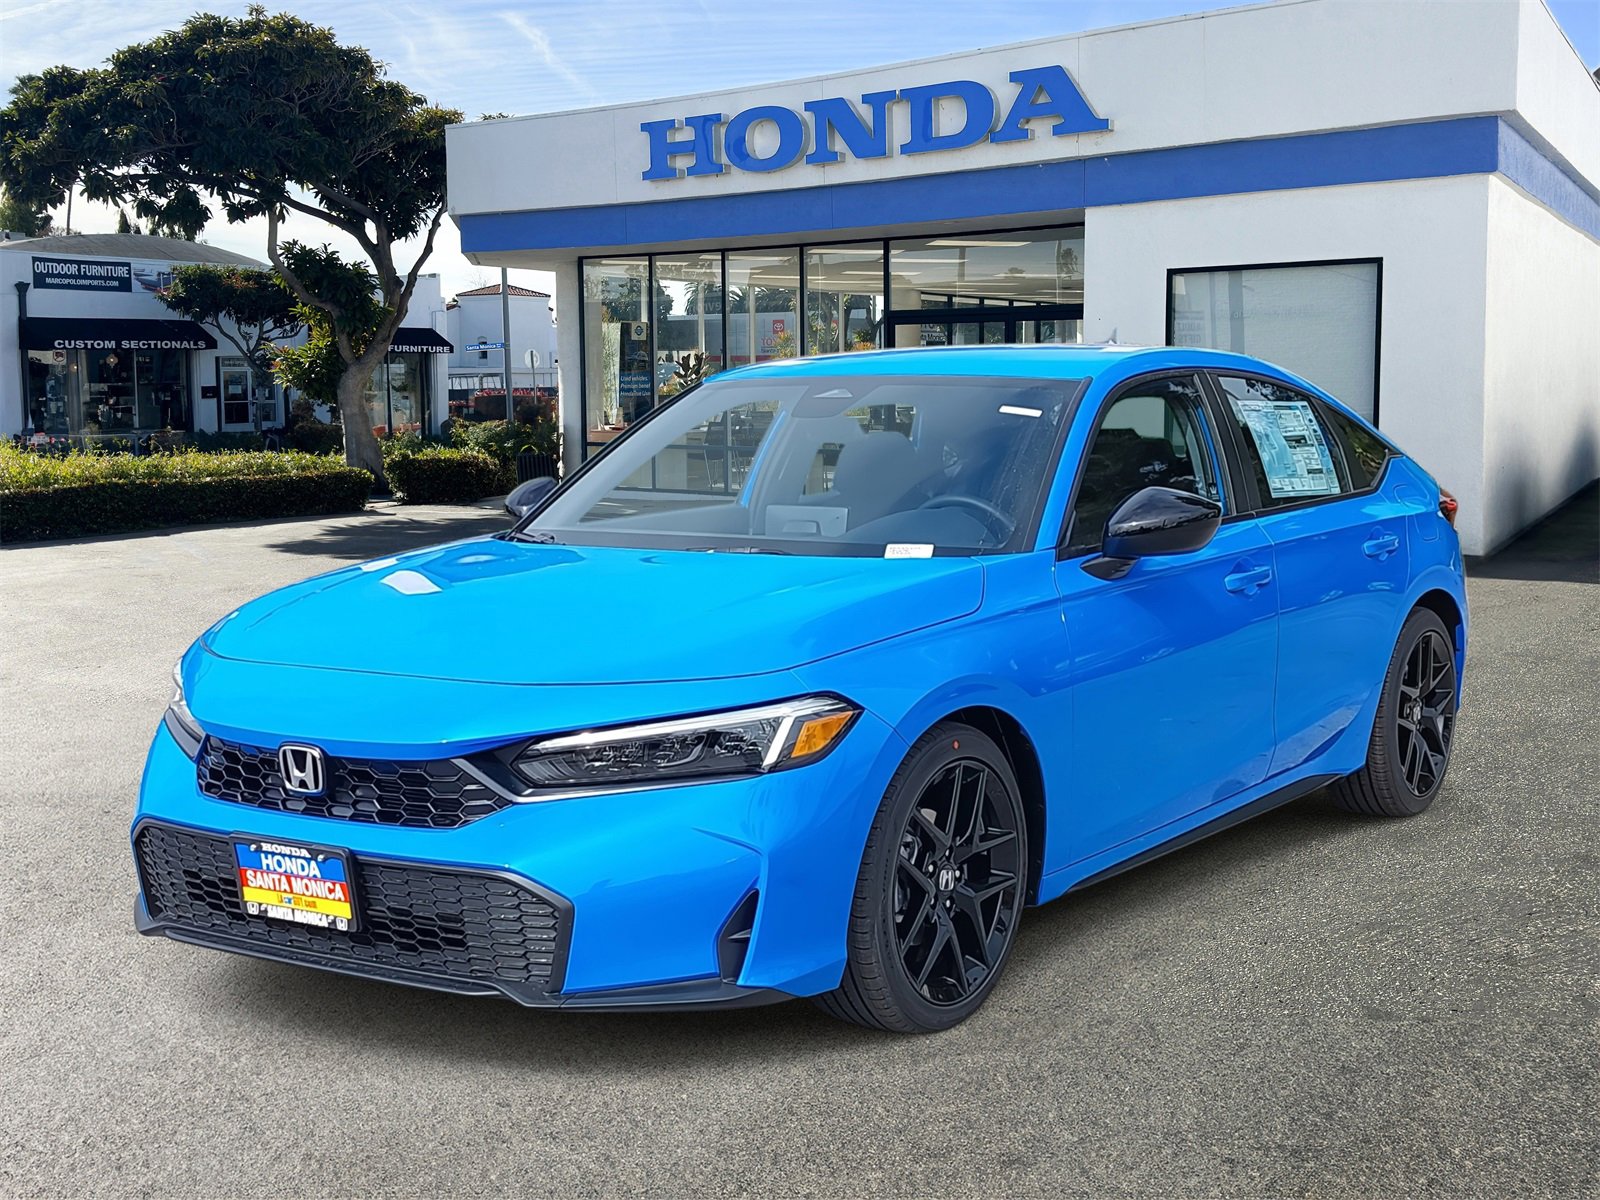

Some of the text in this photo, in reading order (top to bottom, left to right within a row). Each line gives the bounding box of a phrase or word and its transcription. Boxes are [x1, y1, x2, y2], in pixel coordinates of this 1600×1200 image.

[640, 65, 1111, 181] HONDA
[34, 261, 130, 278] OUTDOOR FURNITURE
[45, 277, 119, 287] MARCOPOLOIMPORTS.COM
[54, 339, 206, 349] CUSTOM SECTIONALS
[388, 344, 450, 353] FURNITURE
[260, 842, 311, 858] HONDA
[261, 853, 321, 878] HONDA
[246, 869, 345, 901] SANTA MONICA
[266, 904, 329, 927] SANTA MONICA
